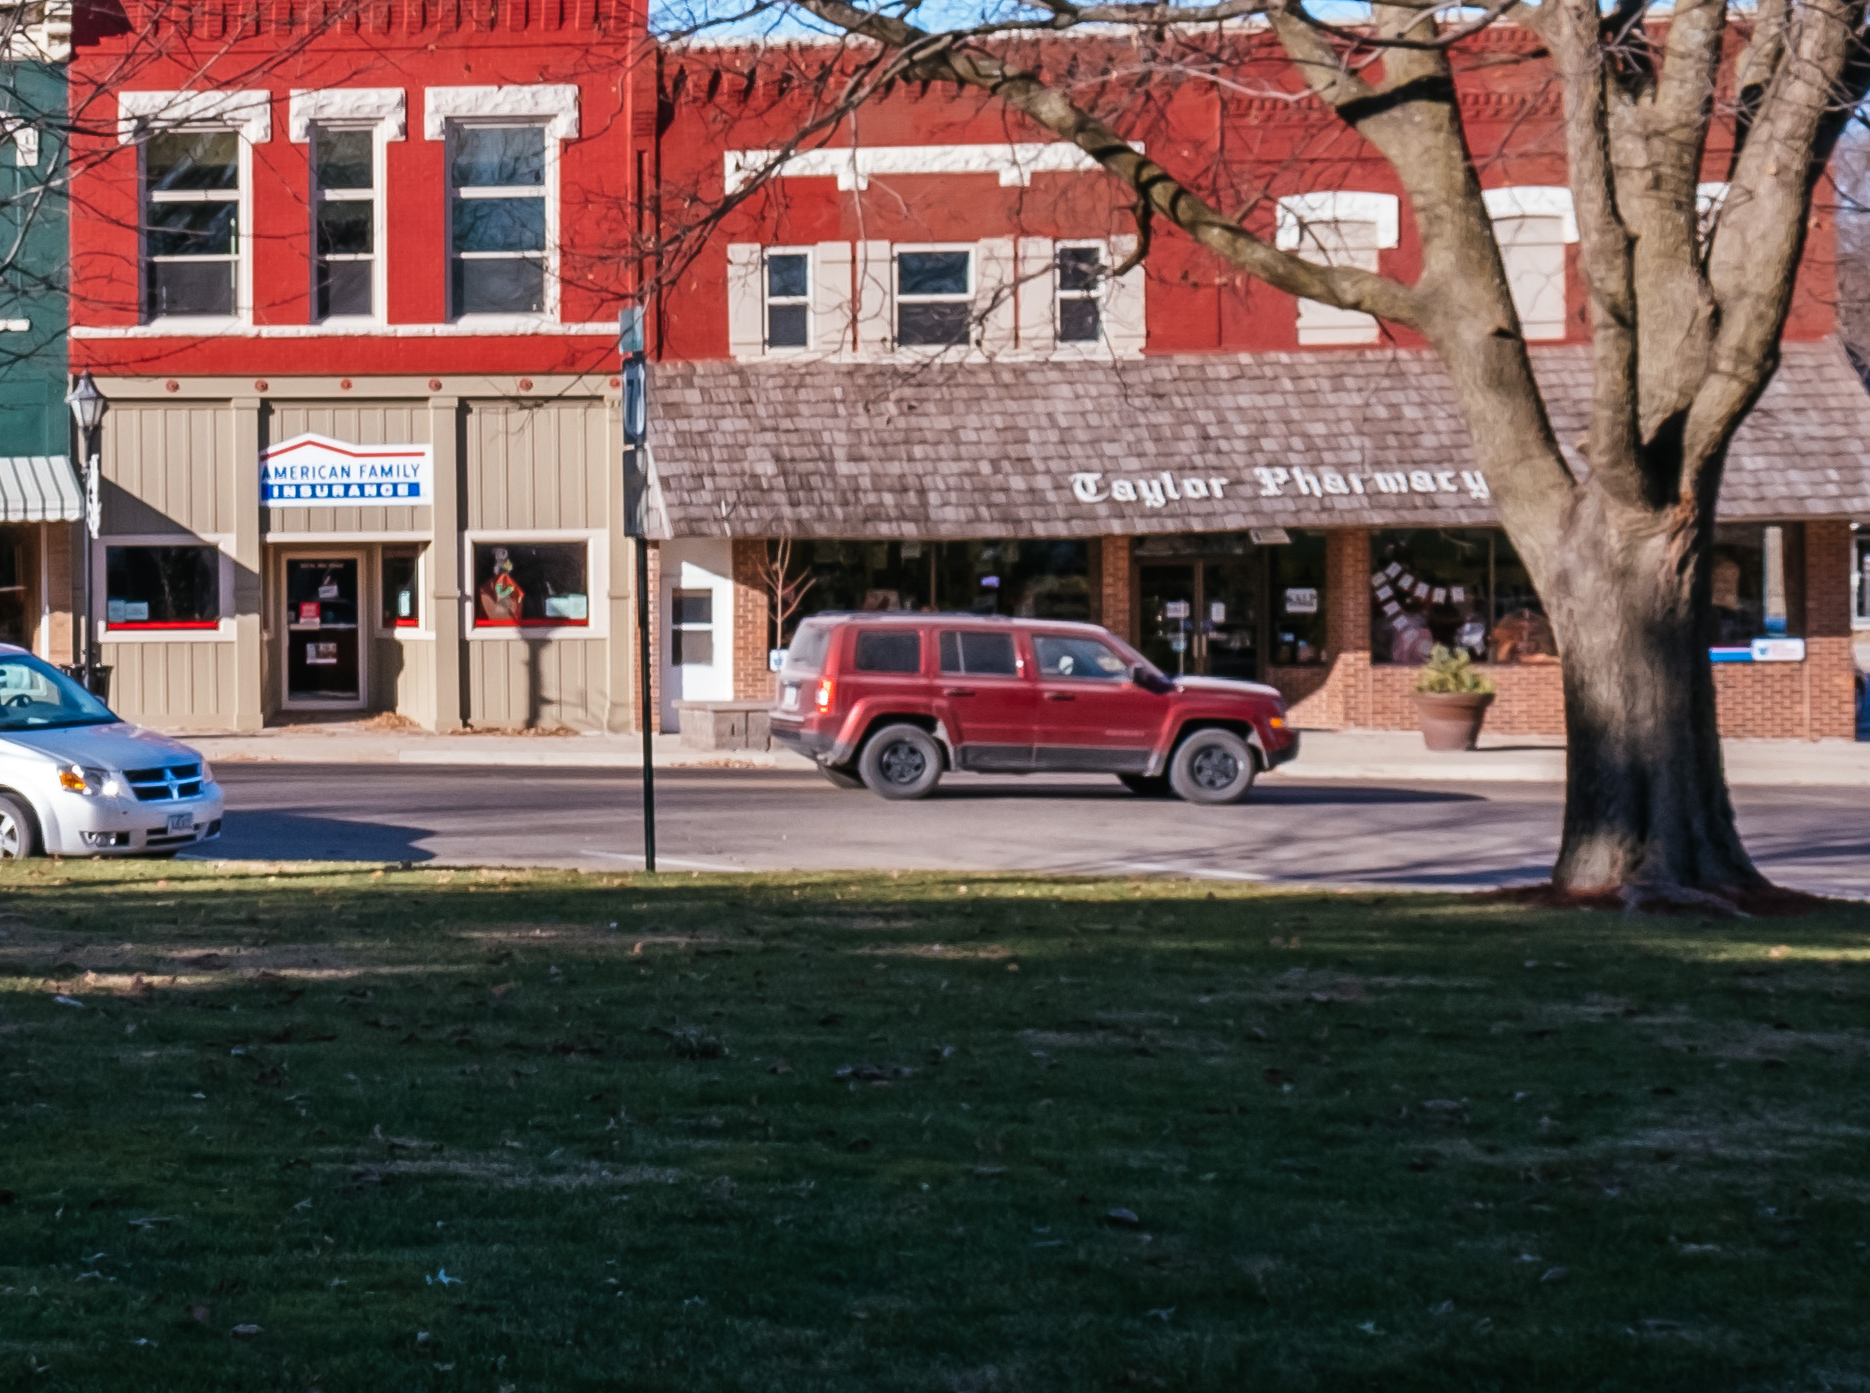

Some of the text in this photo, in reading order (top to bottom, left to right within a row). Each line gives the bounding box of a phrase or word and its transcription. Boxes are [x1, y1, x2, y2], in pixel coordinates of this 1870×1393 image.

[262, 463, 420, 480] AMERICAN FAMILY
[272, 483, 409, 498] INSURANCE
[1070, 466, 1491, 507] Taylor Pharmacy
